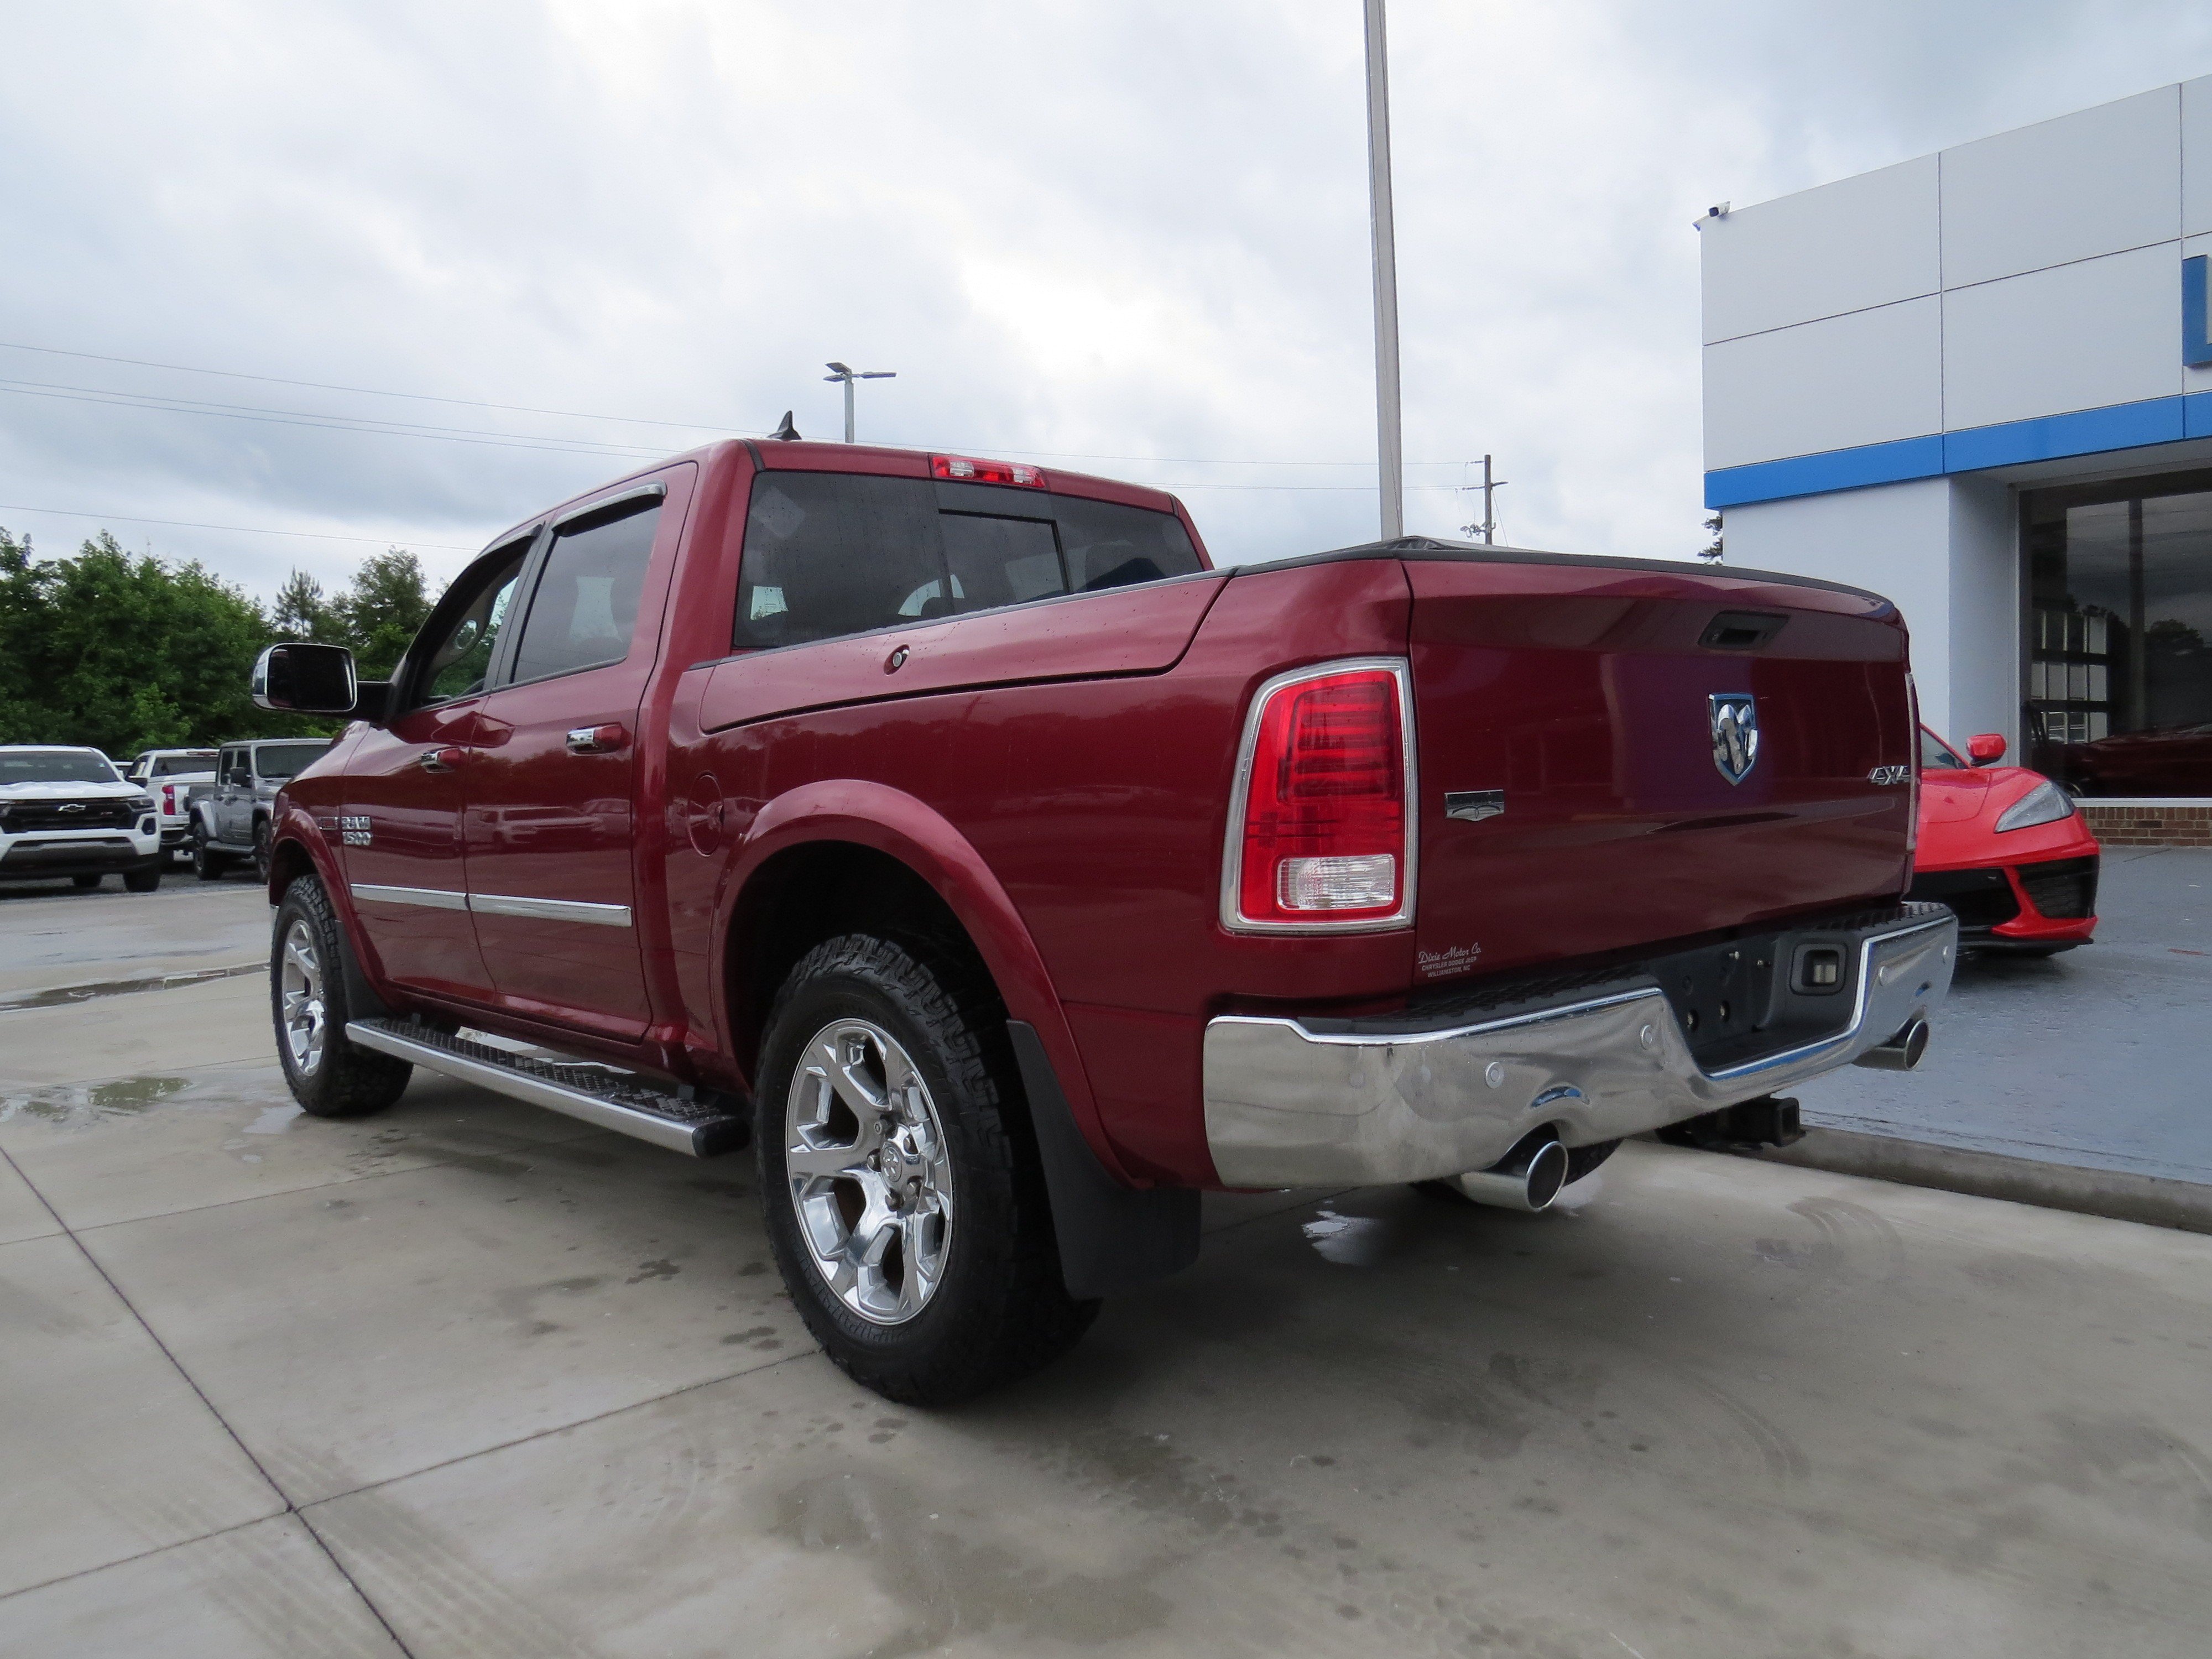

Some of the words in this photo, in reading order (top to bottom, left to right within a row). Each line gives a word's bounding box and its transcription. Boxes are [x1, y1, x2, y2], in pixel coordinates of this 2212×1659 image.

[1418, 951, 1441, 964] Dixie
[1442, 946, 1469, 959] Motor
[1422, 962, 1447, 971] CHRYSLER
